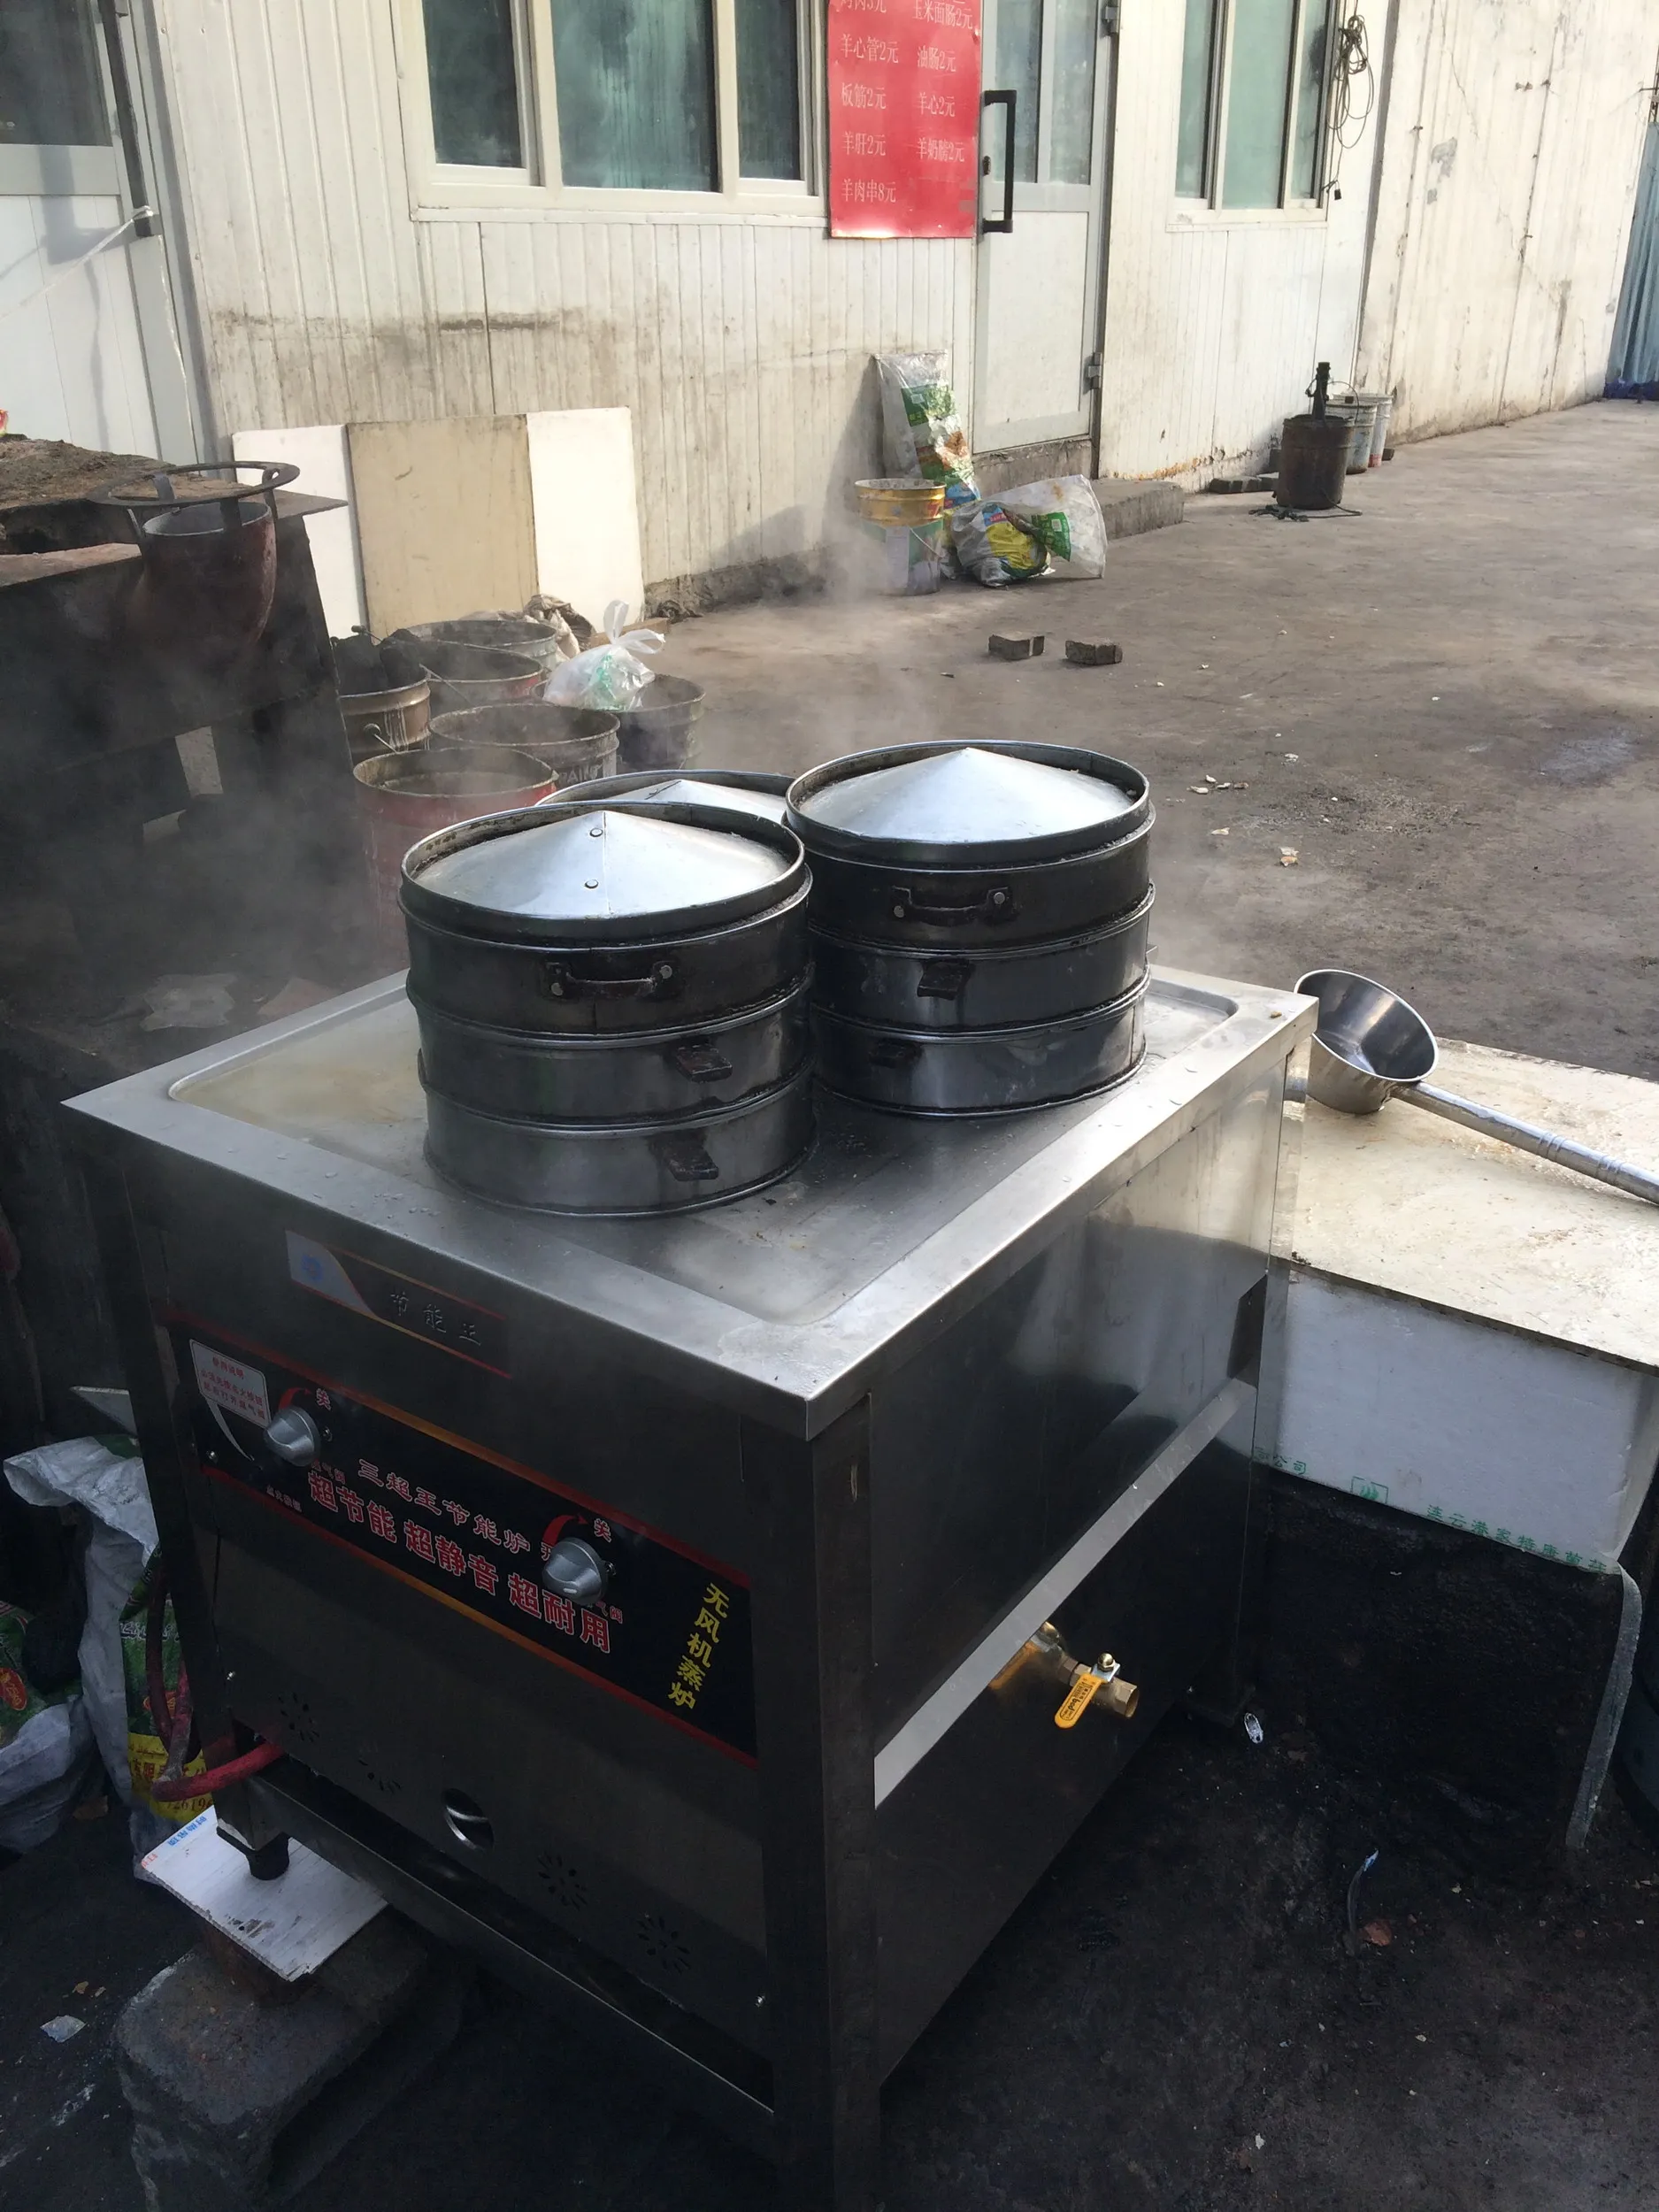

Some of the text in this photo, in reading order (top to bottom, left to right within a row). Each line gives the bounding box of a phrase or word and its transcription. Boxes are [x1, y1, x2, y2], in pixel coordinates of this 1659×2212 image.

[841, 34, 899, 64] 羊心管2元
[917, 45, 956, 73] 油肠2元
[841, 82, 887, 110] 板筋2元
[918, 91, 956, 118] 羊心2元
[842, 131, 886, 157] 羊肝2元
[841, 179, 896, 204] 羊肉串8元
[316, 1387, 332, 1411] 关
[357, 1458, 531, 1554] 三超王节能炉
[594, 1518, 611, 1542] 关
[308, 1471, 611, 1655] 超节能 超静音 超耐用
[668, 1582, 730, 1709] 无风机蒸炉
